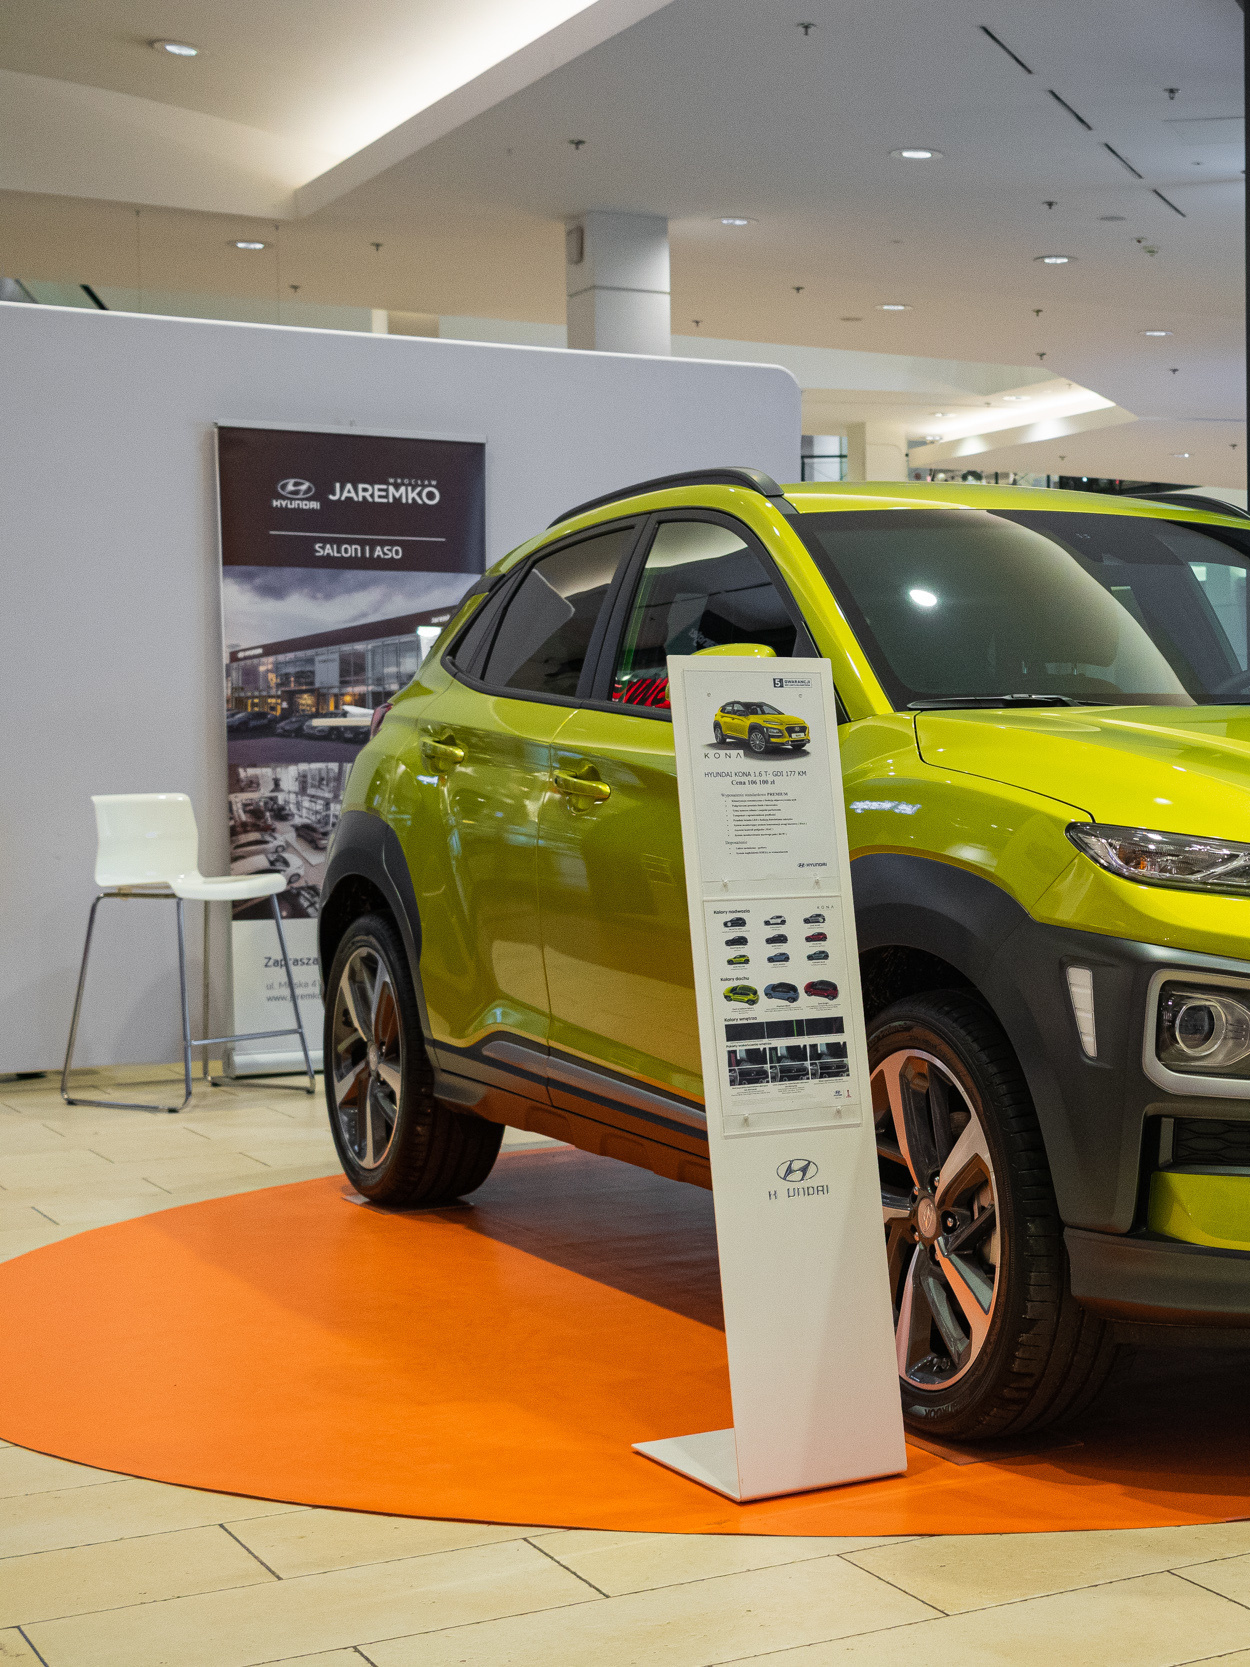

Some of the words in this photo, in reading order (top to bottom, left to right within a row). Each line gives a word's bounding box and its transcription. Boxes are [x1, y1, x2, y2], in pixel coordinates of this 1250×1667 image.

[328, 483, 441, 505] JAREMKO
[272, 499, 320, 510] HYUNDAI
[315, 543, 361, 558] SALON
[365, 545, 369, 558] I
[374, 546, 403, 559] ASO
[775, 679, 781, 687] 5
[704, 752, 743, 760] KONA
[264, 956, 319, 968] Zapasza
